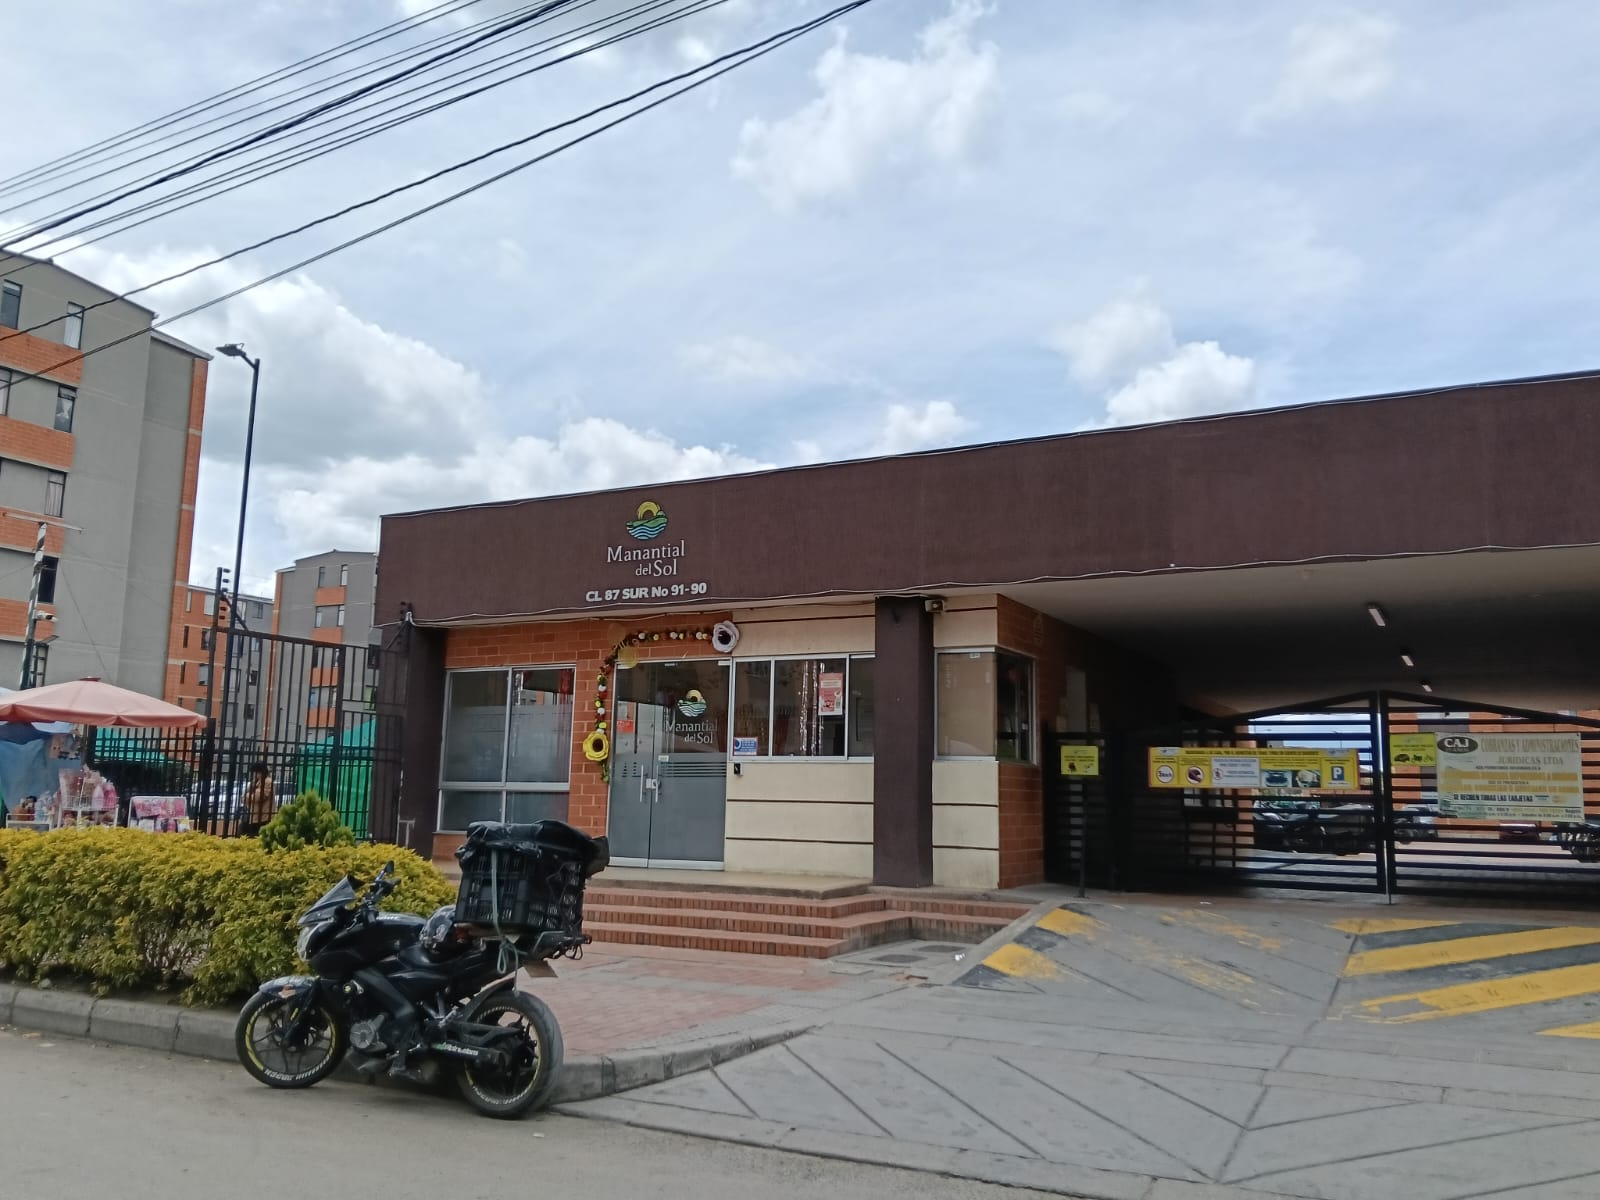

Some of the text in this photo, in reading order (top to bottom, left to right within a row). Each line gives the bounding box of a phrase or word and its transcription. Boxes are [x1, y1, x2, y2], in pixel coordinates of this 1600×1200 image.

[607, 540, 685, 562] Manantial
[635, 559, 677, 577] del Sol
[586, 591, 602, 601] CL
[605, 589, 620, 600] 87
[622, 587, 649, 599] SUR
[651, 586, 668, 597] No
[666, 718, 717, 732] Manantial
[684, 731, 713, 744] del Sol
[1443, 738, 1469, 748] CAJ
